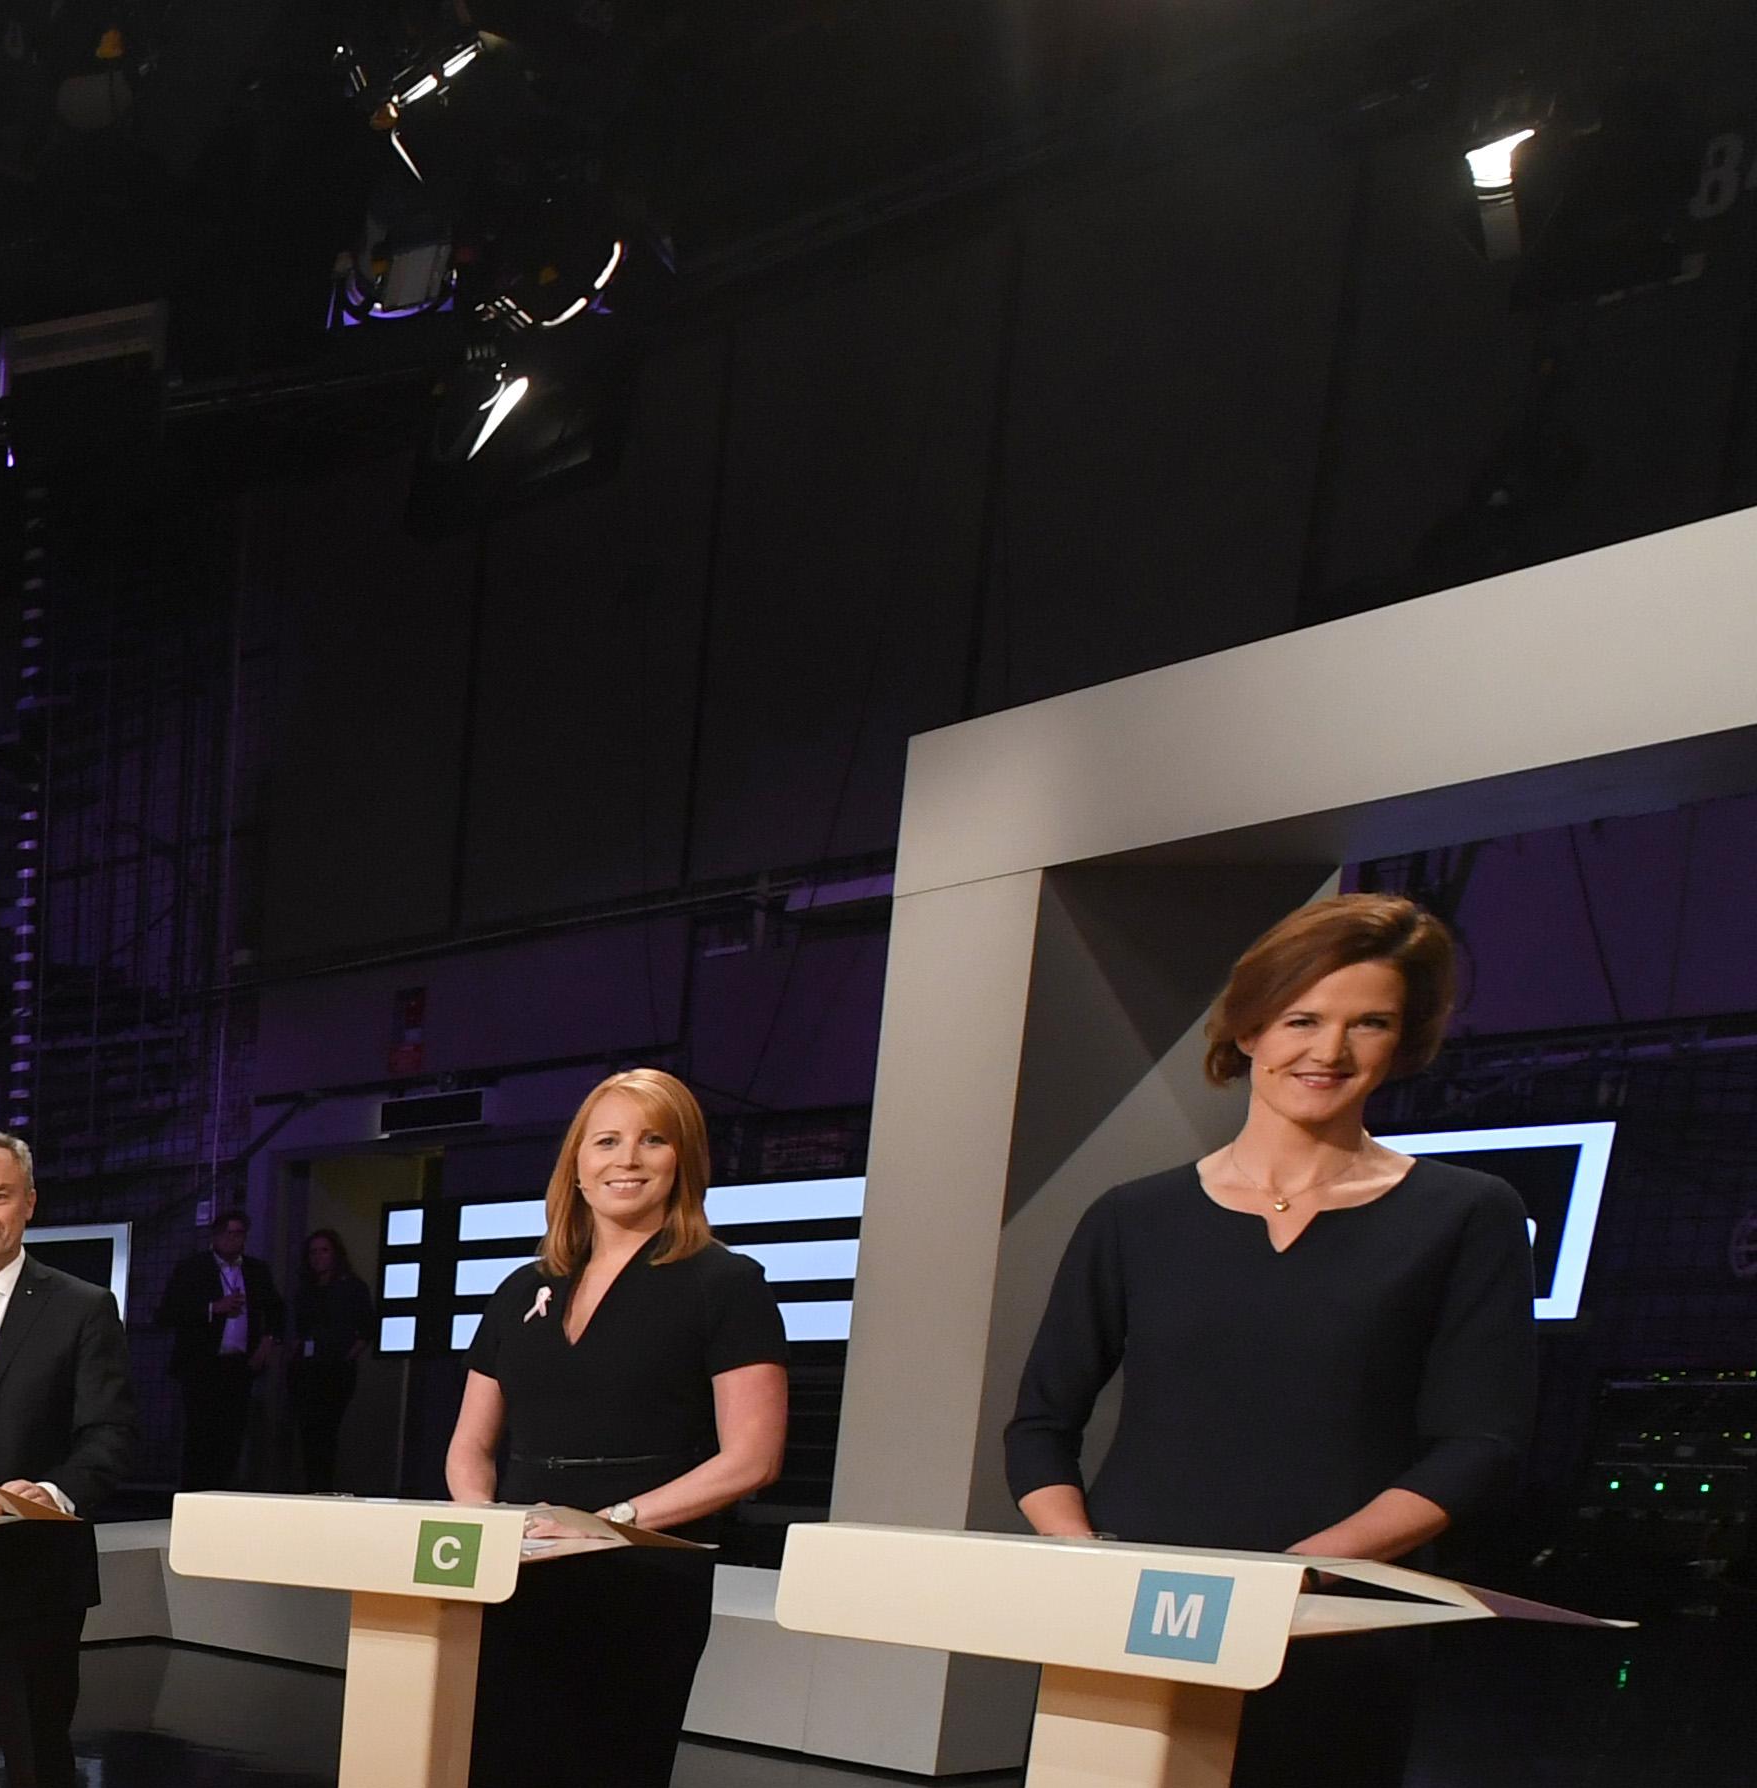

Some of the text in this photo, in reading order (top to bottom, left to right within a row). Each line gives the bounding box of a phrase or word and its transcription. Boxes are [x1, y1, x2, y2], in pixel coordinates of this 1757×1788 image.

[1687, 130, 1757, 222] 8
[431, 1535, 462, 1571] C
[1150, 1590, 1206, 1640] M
